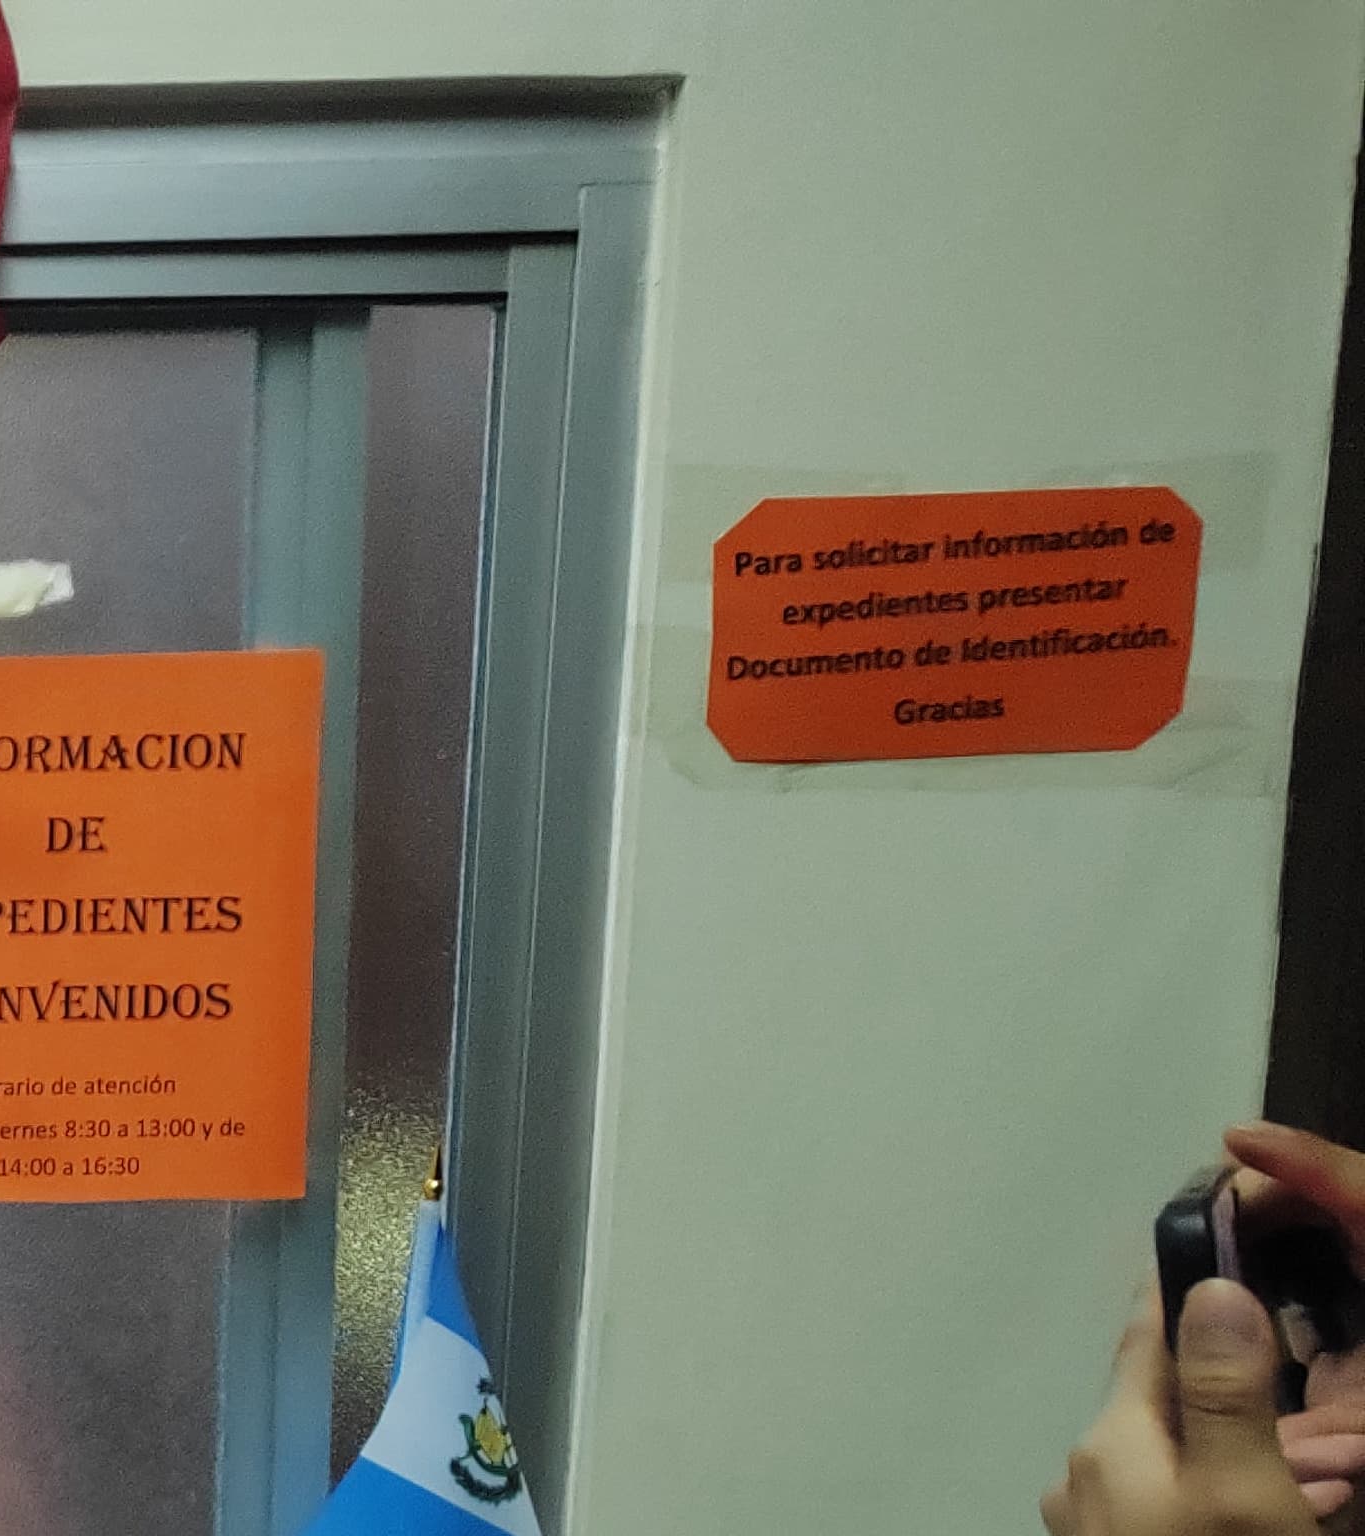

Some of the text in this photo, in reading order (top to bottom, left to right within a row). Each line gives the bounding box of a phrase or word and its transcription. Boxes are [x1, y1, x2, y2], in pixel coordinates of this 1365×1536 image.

[735, 518, 1176, 576] Para solicitar información de
[781, 578, 1129, 632] expedientes presentar
[726, 647, 906, 680] Documento
[915, 639, 951, 667] de
[893, 695, 1005, 724] Gracias
[45, 816, 108, 853] DE
[51, 1075, 76, 1096] de
[83, 1073, 176, 1096] atención
[65, 1119, 111, 1139] 8:30
[117, 1124, 129, 1138] a
[136, 1118, 195, 1138] 13:00
[201, 1121, 214, 1142] y
[220, 1117, 245, 1137] de
[62, 1161, 74, 1177] a
[82, 1156, 140, 1176] 16:30
